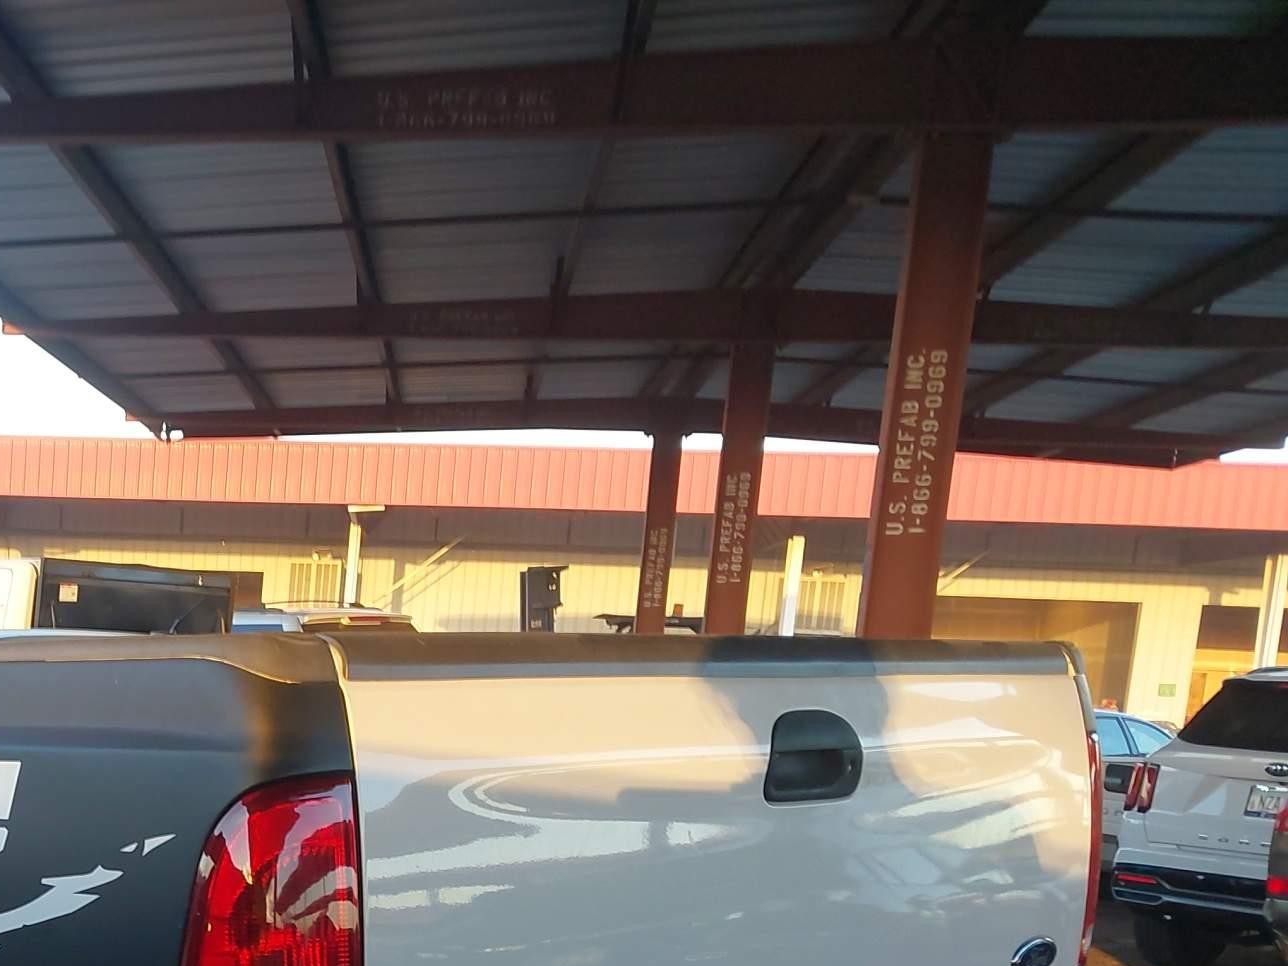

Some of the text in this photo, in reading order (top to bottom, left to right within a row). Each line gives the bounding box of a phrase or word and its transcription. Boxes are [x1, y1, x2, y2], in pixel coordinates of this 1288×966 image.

[885, 348, 927, 536] U.S. PREFAB INC.
[908, 349, 948, 534] 1-866-799-0969
